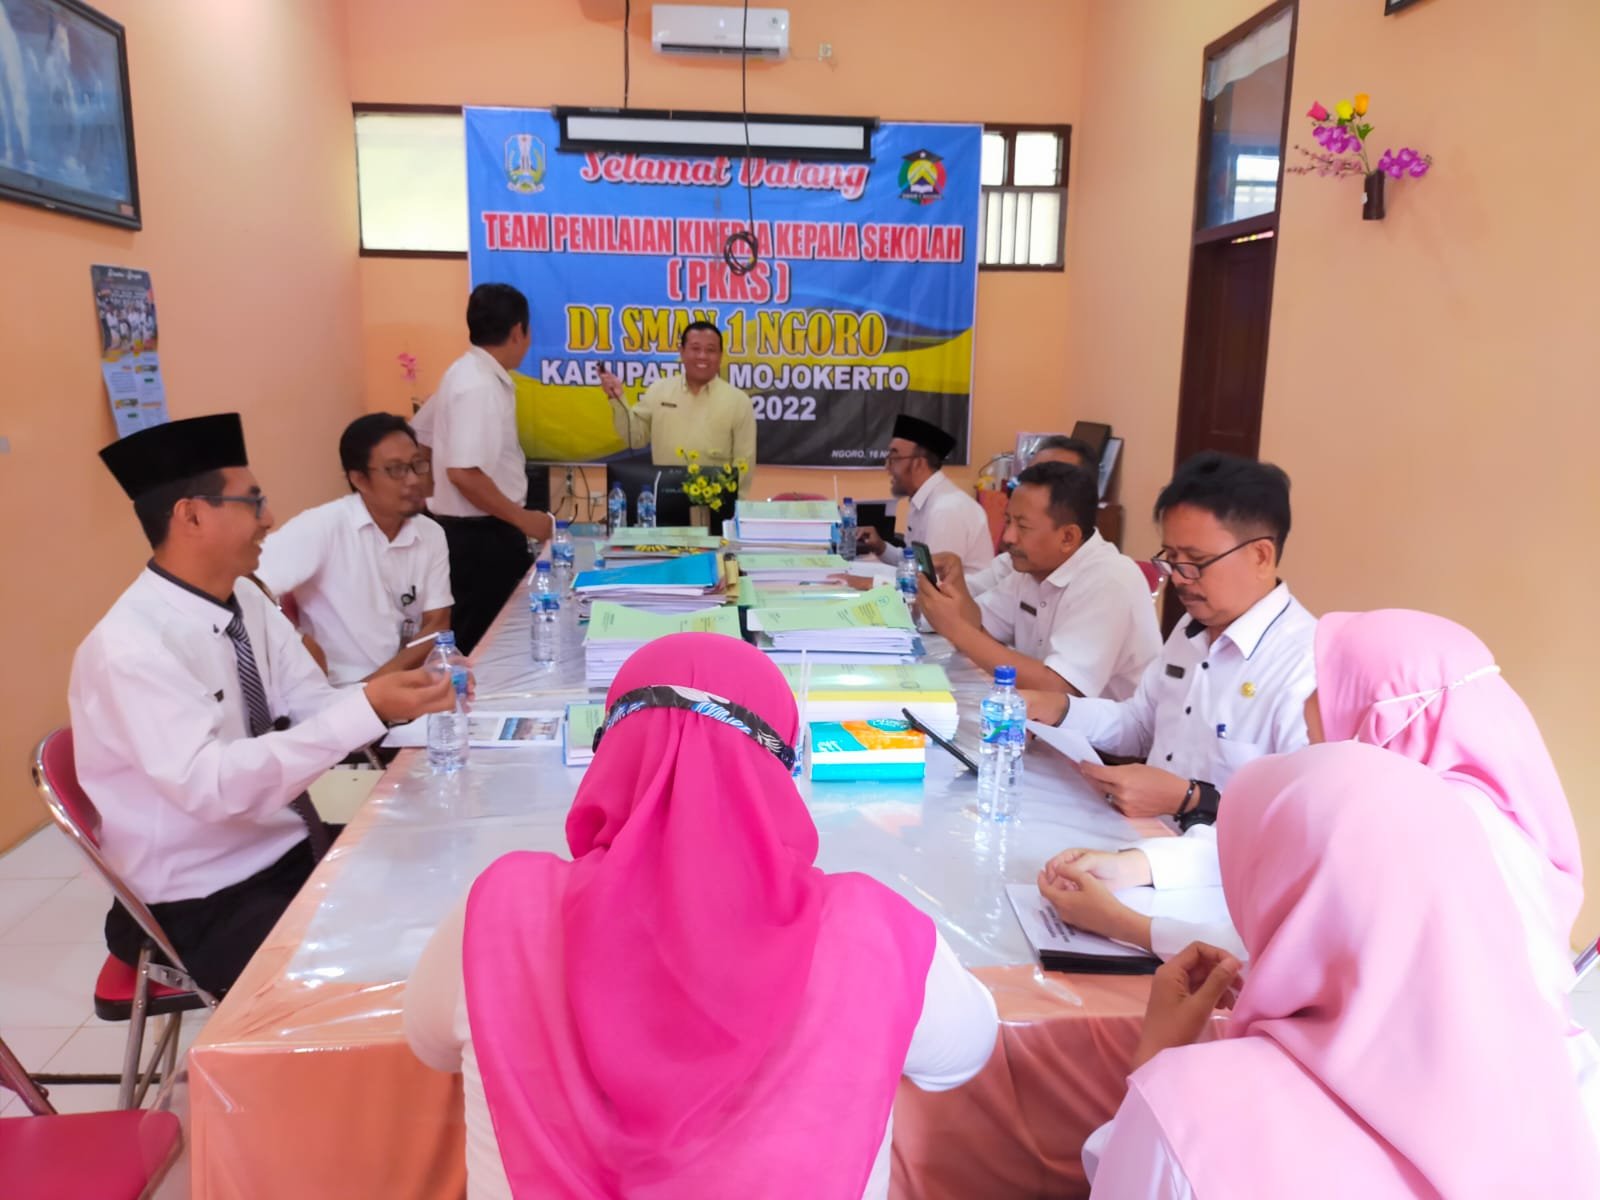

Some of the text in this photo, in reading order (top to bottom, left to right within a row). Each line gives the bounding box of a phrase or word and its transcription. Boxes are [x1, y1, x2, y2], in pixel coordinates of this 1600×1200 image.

[580, 151, 732, 186] Selamat
[482, 212, 549, 250] TEAM
[551, 215, 674, 253] PENILAIAN
[774, 221, 860, 260] KEPALA
[862, 224, 963, 262] SEKOLAH
[565, 305, 614, 352] DI
[727, 309, 745, 356] 1
[756, 309, 887, 357] NGORO
[541, 359, 909, 391] KABUPAT MOJOKERTO
[752, 396, 816, 420] 2022
